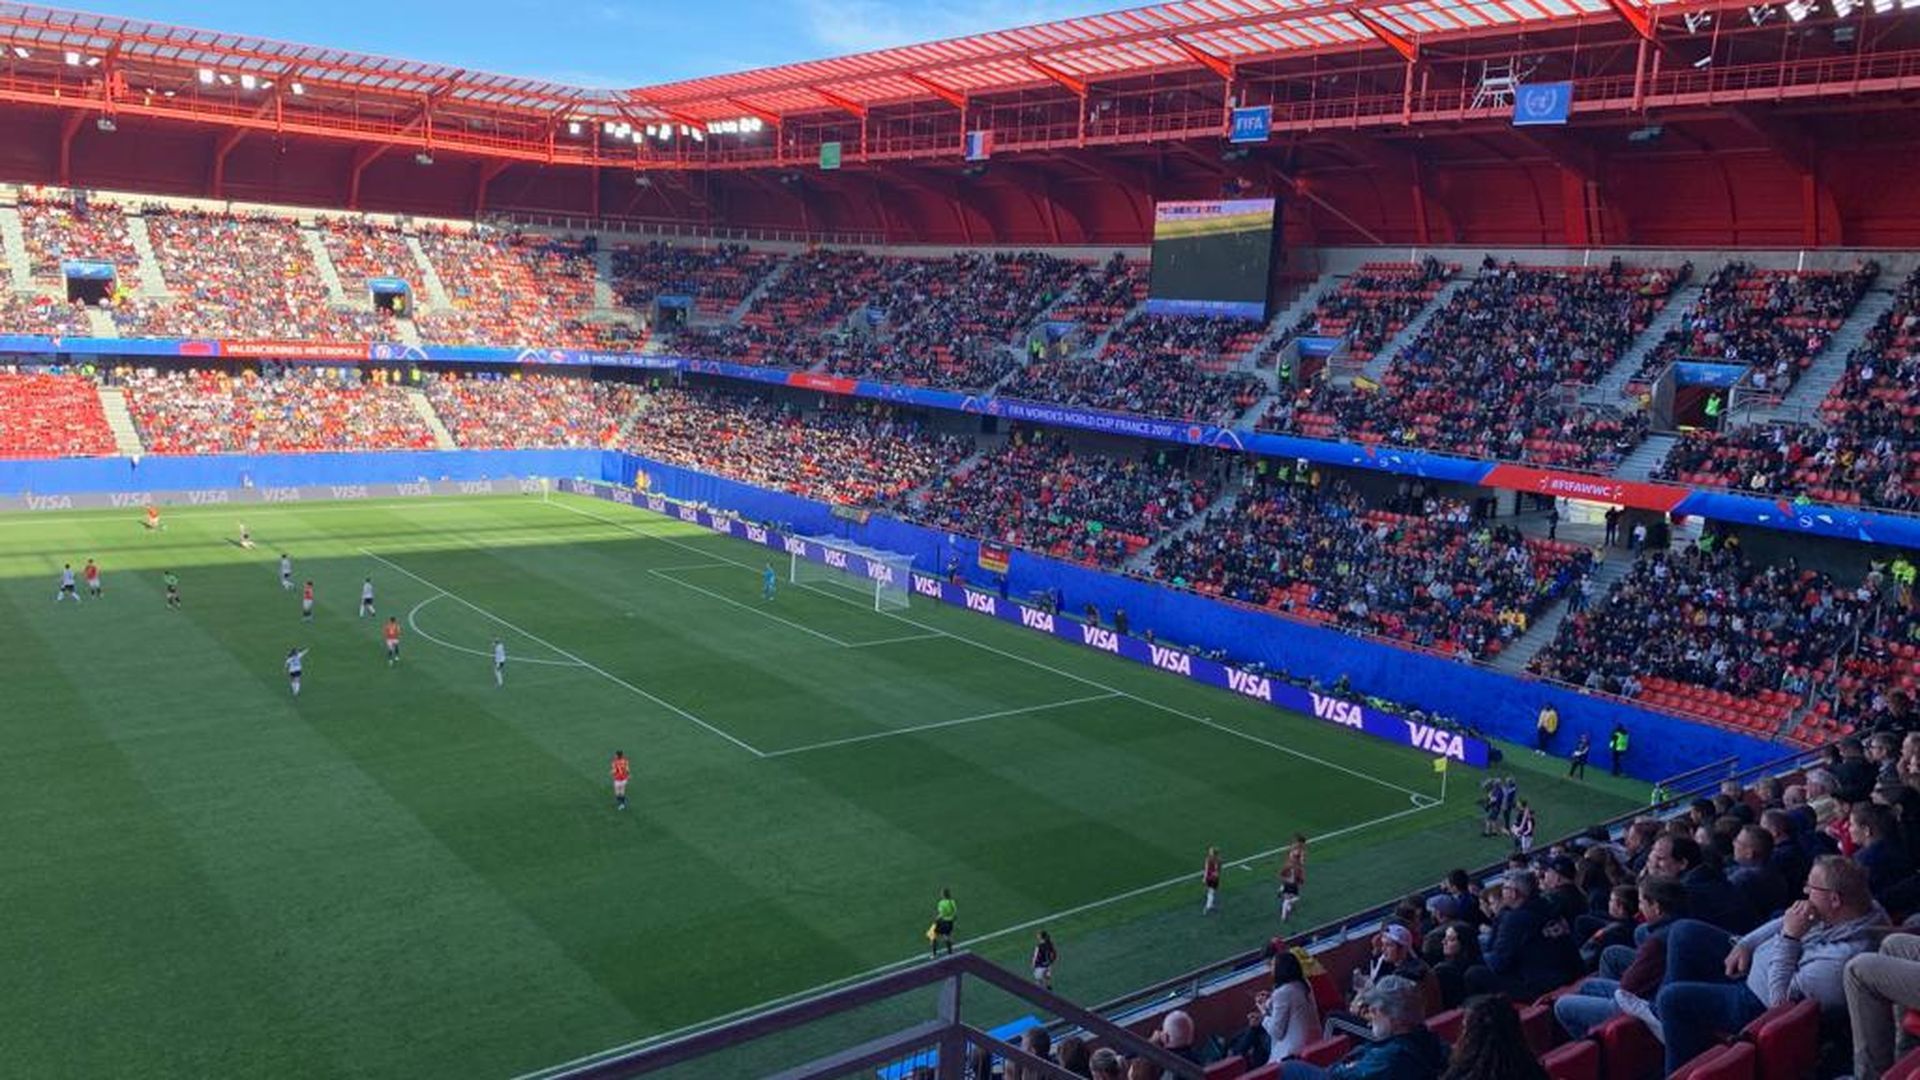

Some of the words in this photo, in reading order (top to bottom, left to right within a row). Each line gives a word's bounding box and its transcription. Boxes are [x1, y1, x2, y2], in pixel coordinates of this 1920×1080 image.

[1236, 117, 1263, 130] FIFA
[226, 344, 302, 355] VALENCIENNES
[1008, 405, 1024, 416] FIFA
[1064, 411, 1094, 426] WORLD
[1095, 414, 1114, 429] CUP
[1115, 417, 1150, 433] FRANCE
[1151, 423, 1172, 436] 2019
[186, 490, 228, 505] VISA
[264, 487, 300, 502] VISA
[331, 485, 368, 499] VISA
[397, 483, 432, 497] VISA
[1551, 480, 1611, 497] #FIFAWWC
[26, 494, 73, 510] VISA
[745, 523, 768, 545] VISA
[782, 536, 806, 556] VISA
[865, 560, 893, 583] VISA
[913, 574, 942, 598] VISA
[964, 588, 996, 616] VISA
[1019, 605, 1055, 633] VISA
[1080, 624, 1119, 653] VISA
[1148, 643, 1191, 676] VISA
[1224, 666, 1271, 701] VISA
[1308, 691, 1363, 729] VISA
[1404, 719, 1464, 761] VISA
